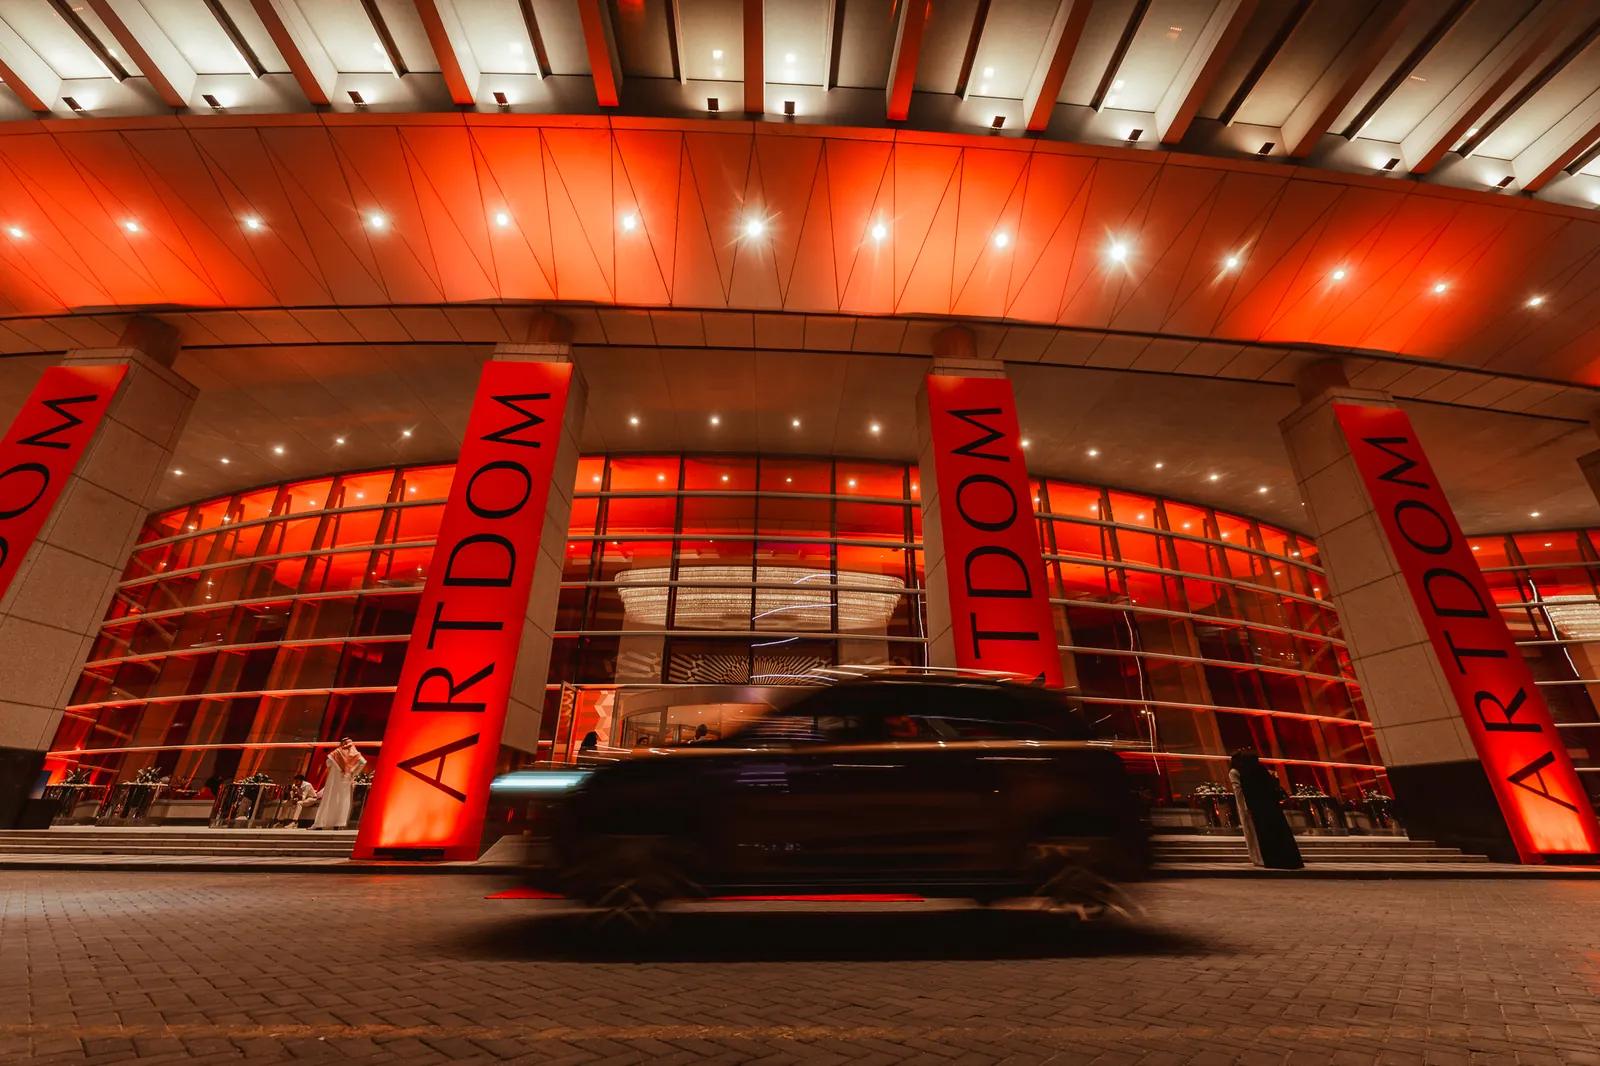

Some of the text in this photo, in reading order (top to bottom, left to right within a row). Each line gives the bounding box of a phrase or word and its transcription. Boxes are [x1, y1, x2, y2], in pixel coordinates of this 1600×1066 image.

[0, 394, 99, 568] OM
[396, 392, 551, 803] ARTDOM
[946, 407, 1046, 685] TDOM
[1361, 436, 1579, 813] ARTDOM
